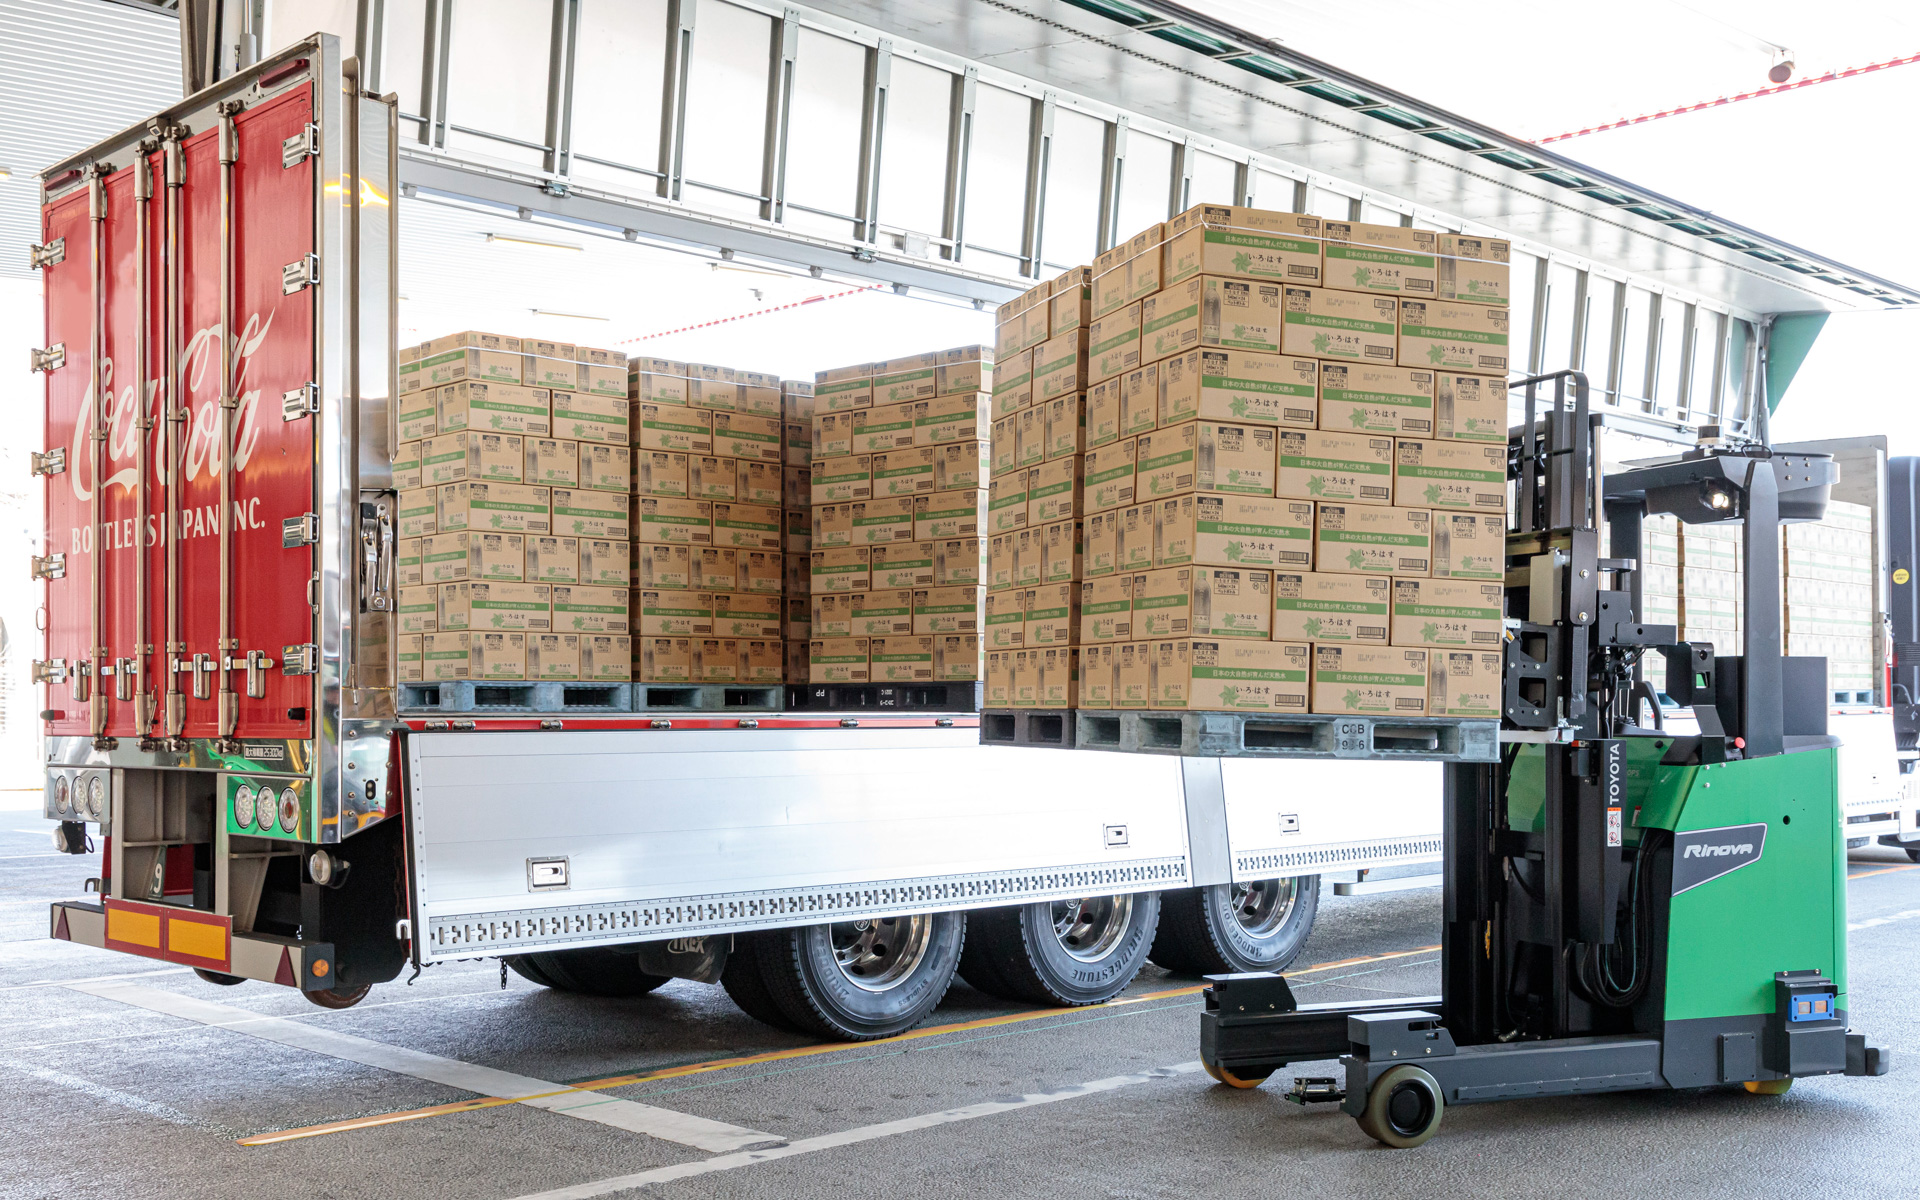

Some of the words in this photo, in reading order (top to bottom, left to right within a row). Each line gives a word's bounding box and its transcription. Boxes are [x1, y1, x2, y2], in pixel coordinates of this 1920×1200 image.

[1224, 235, 1299, 250] 日本の大自然が育んだ天然水
[1345, 250, 1416, 264] 日本の大自然が育んだ天然水
[1304, 316, 1376, 331] 日本の大自然が育んだ天然水
[1420, 328, 1489, 341] 日本の大自然が育んだ天然水
[1222, 379, 1295, 393] 日本の大自然が育んだ天然水
[1342, 392, 1413, 404] 日本の大自然が育んだ天然水
[1300, 459, 1371, 471] 日本の大自然が育んだ天然水
[1416, 468, 1486, 479] 日本の大自然が育んだ天然水
[72, 514, 156, 555] BOTLES
[160, 504, 219, 548] JPAN
[228, 497, 265, 531] NC.
[1217, 524, 1291, 536] 日本の大自然が育んだ天然水
[1339, 533, 1410, 543] 日本の大自然が育んだ天然水
[1296, 601, 1368, 611] 日本の大自然が育んだ天然水
[1413, 607, 1482, 617] 日本の大自然が育んだ天然水
[1212, 669, 1286, 679] 日本の大自然が育んだ天然水
[1336, 673, 1406, 683] 日本の大自然が育んだ天然水
[1610, 743, 1620, 805] TOYOTA
[1683, 843, 1753, 859] Rinova
[1071, 926, 1143, 982] BRIDGESTONE
